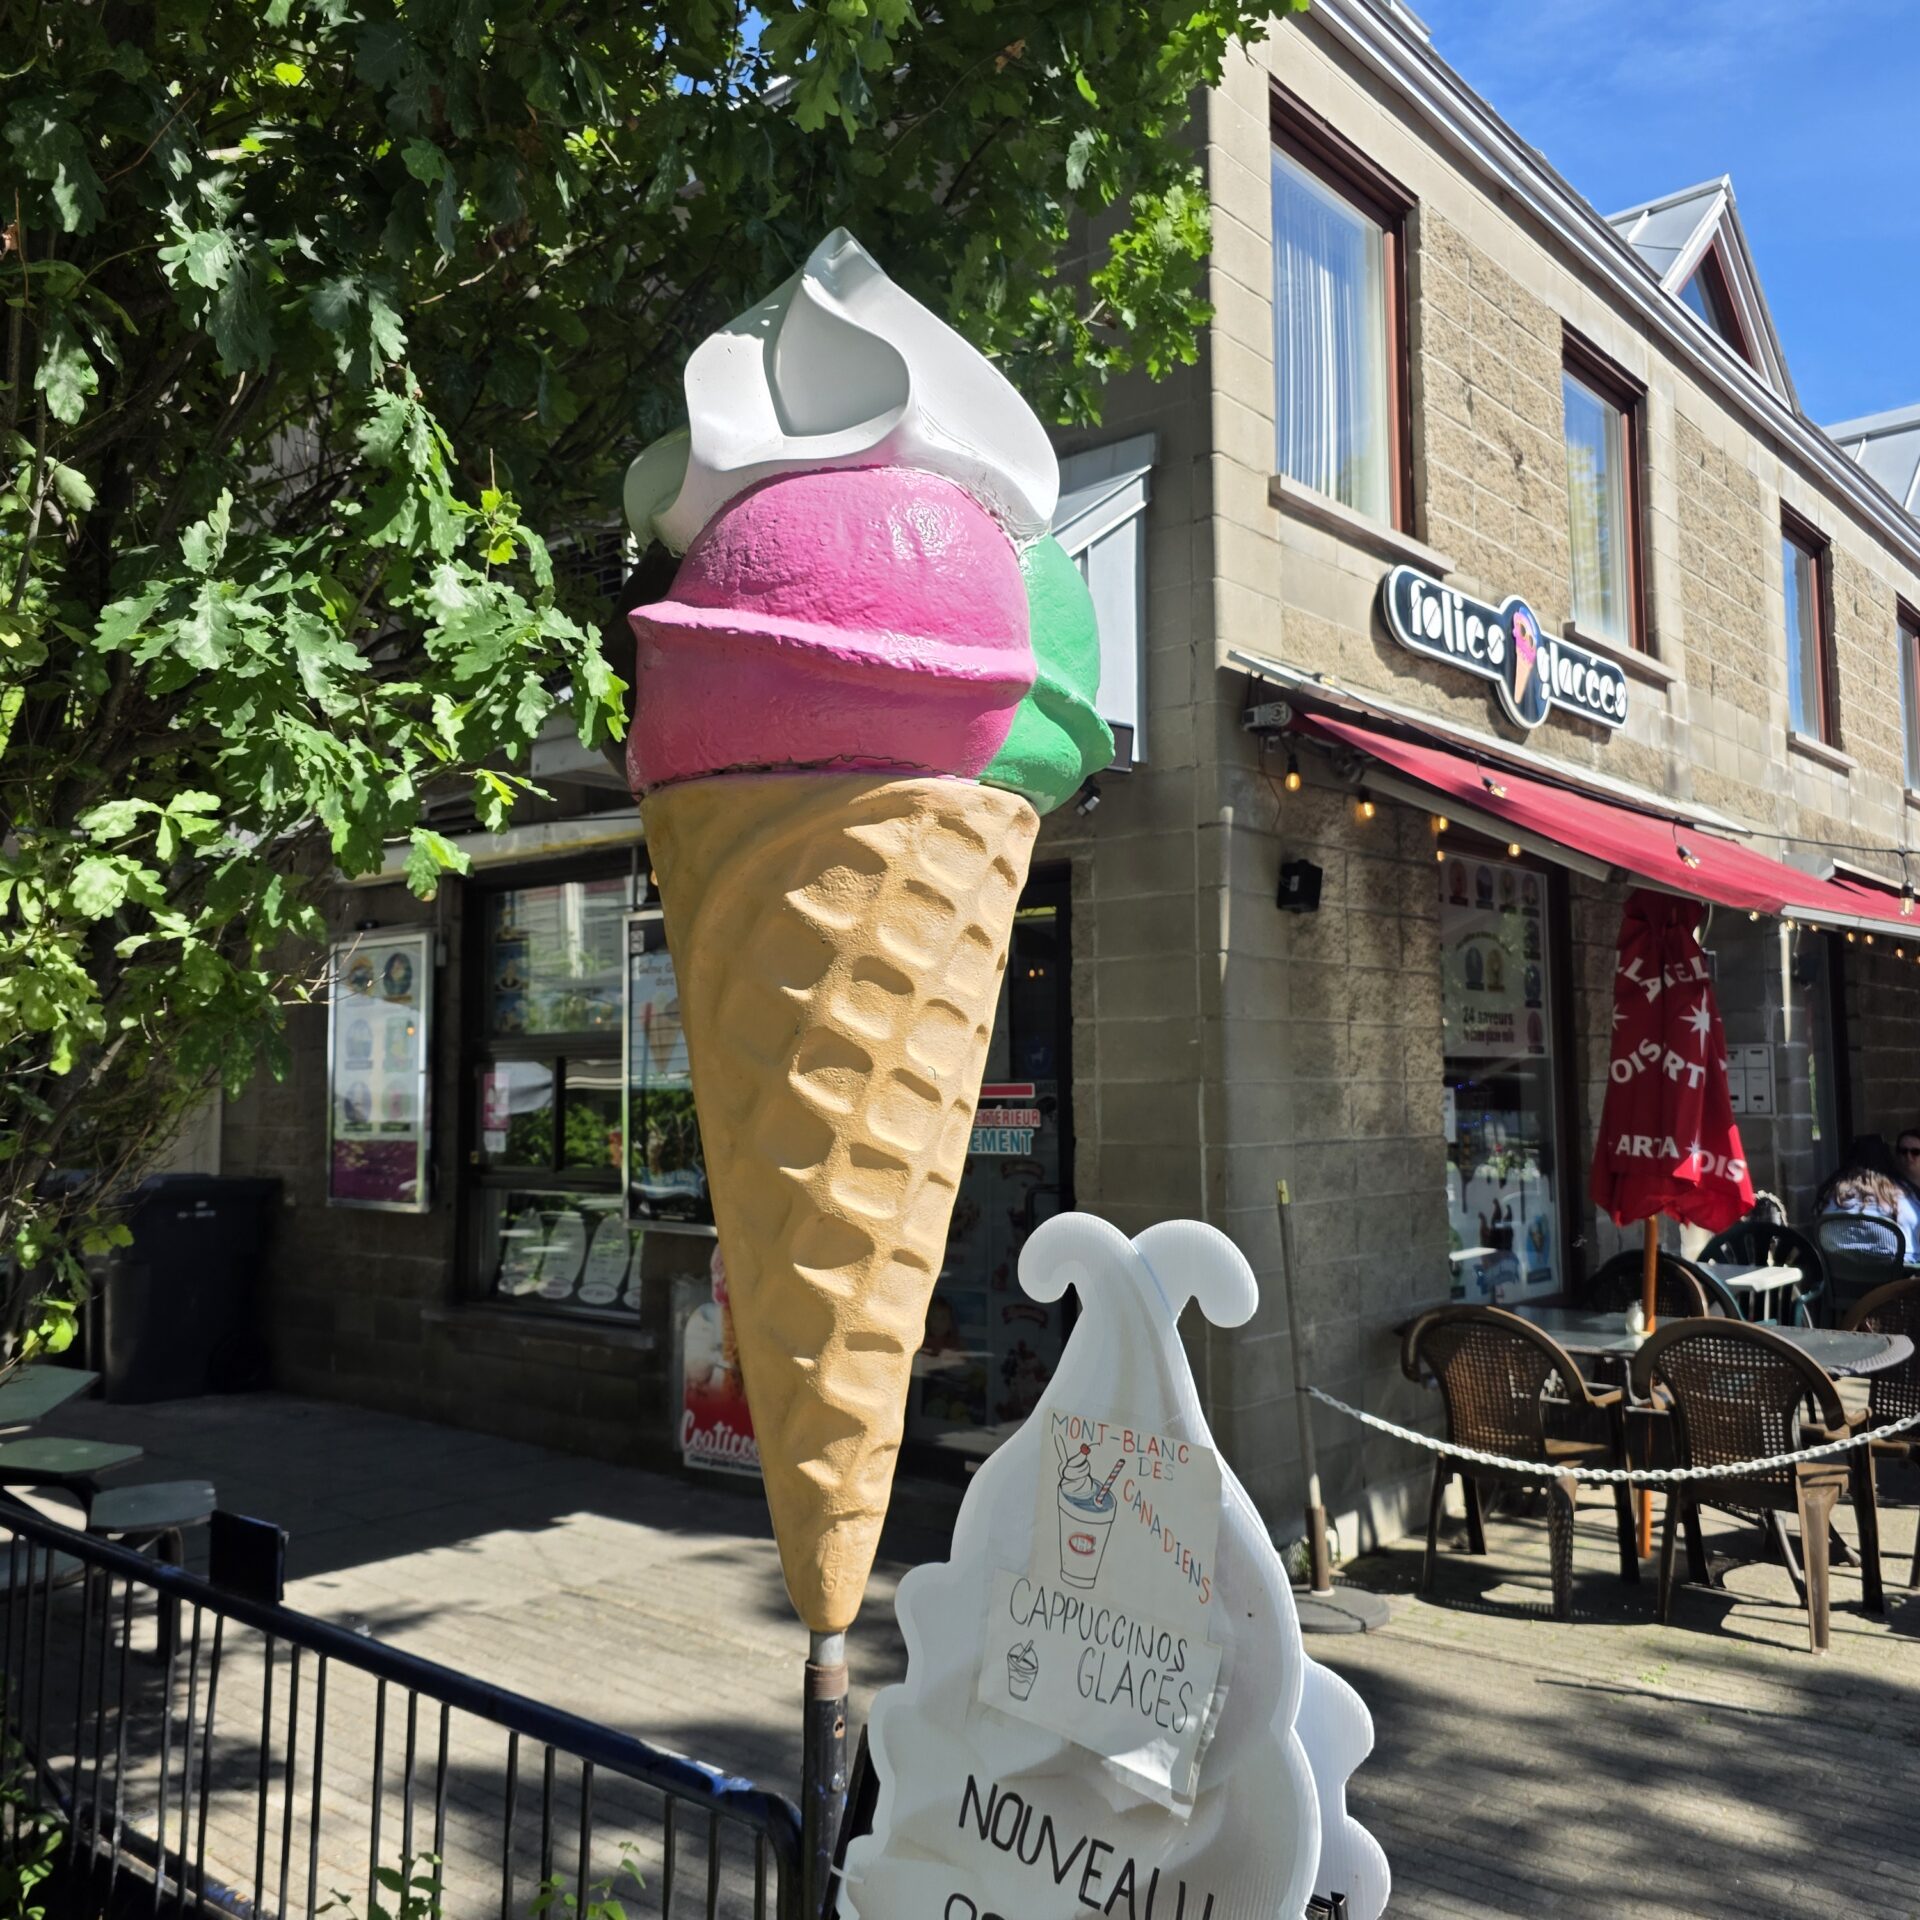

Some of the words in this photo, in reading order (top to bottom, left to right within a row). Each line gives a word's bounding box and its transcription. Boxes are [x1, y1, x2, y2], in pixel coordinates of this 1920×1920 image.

[1410, 580, 1506, 665] folies
[1536, 642, 1627, 718] glacées
[1050, 1412, 1190, 1465] MONT-BLANC
[1138, 1457, 1175, 1481] DES
[1122, 1478, 1213, 1605] CANADIENS
[1009, 1577, 1188, 1672] CAPPUCCINOS
